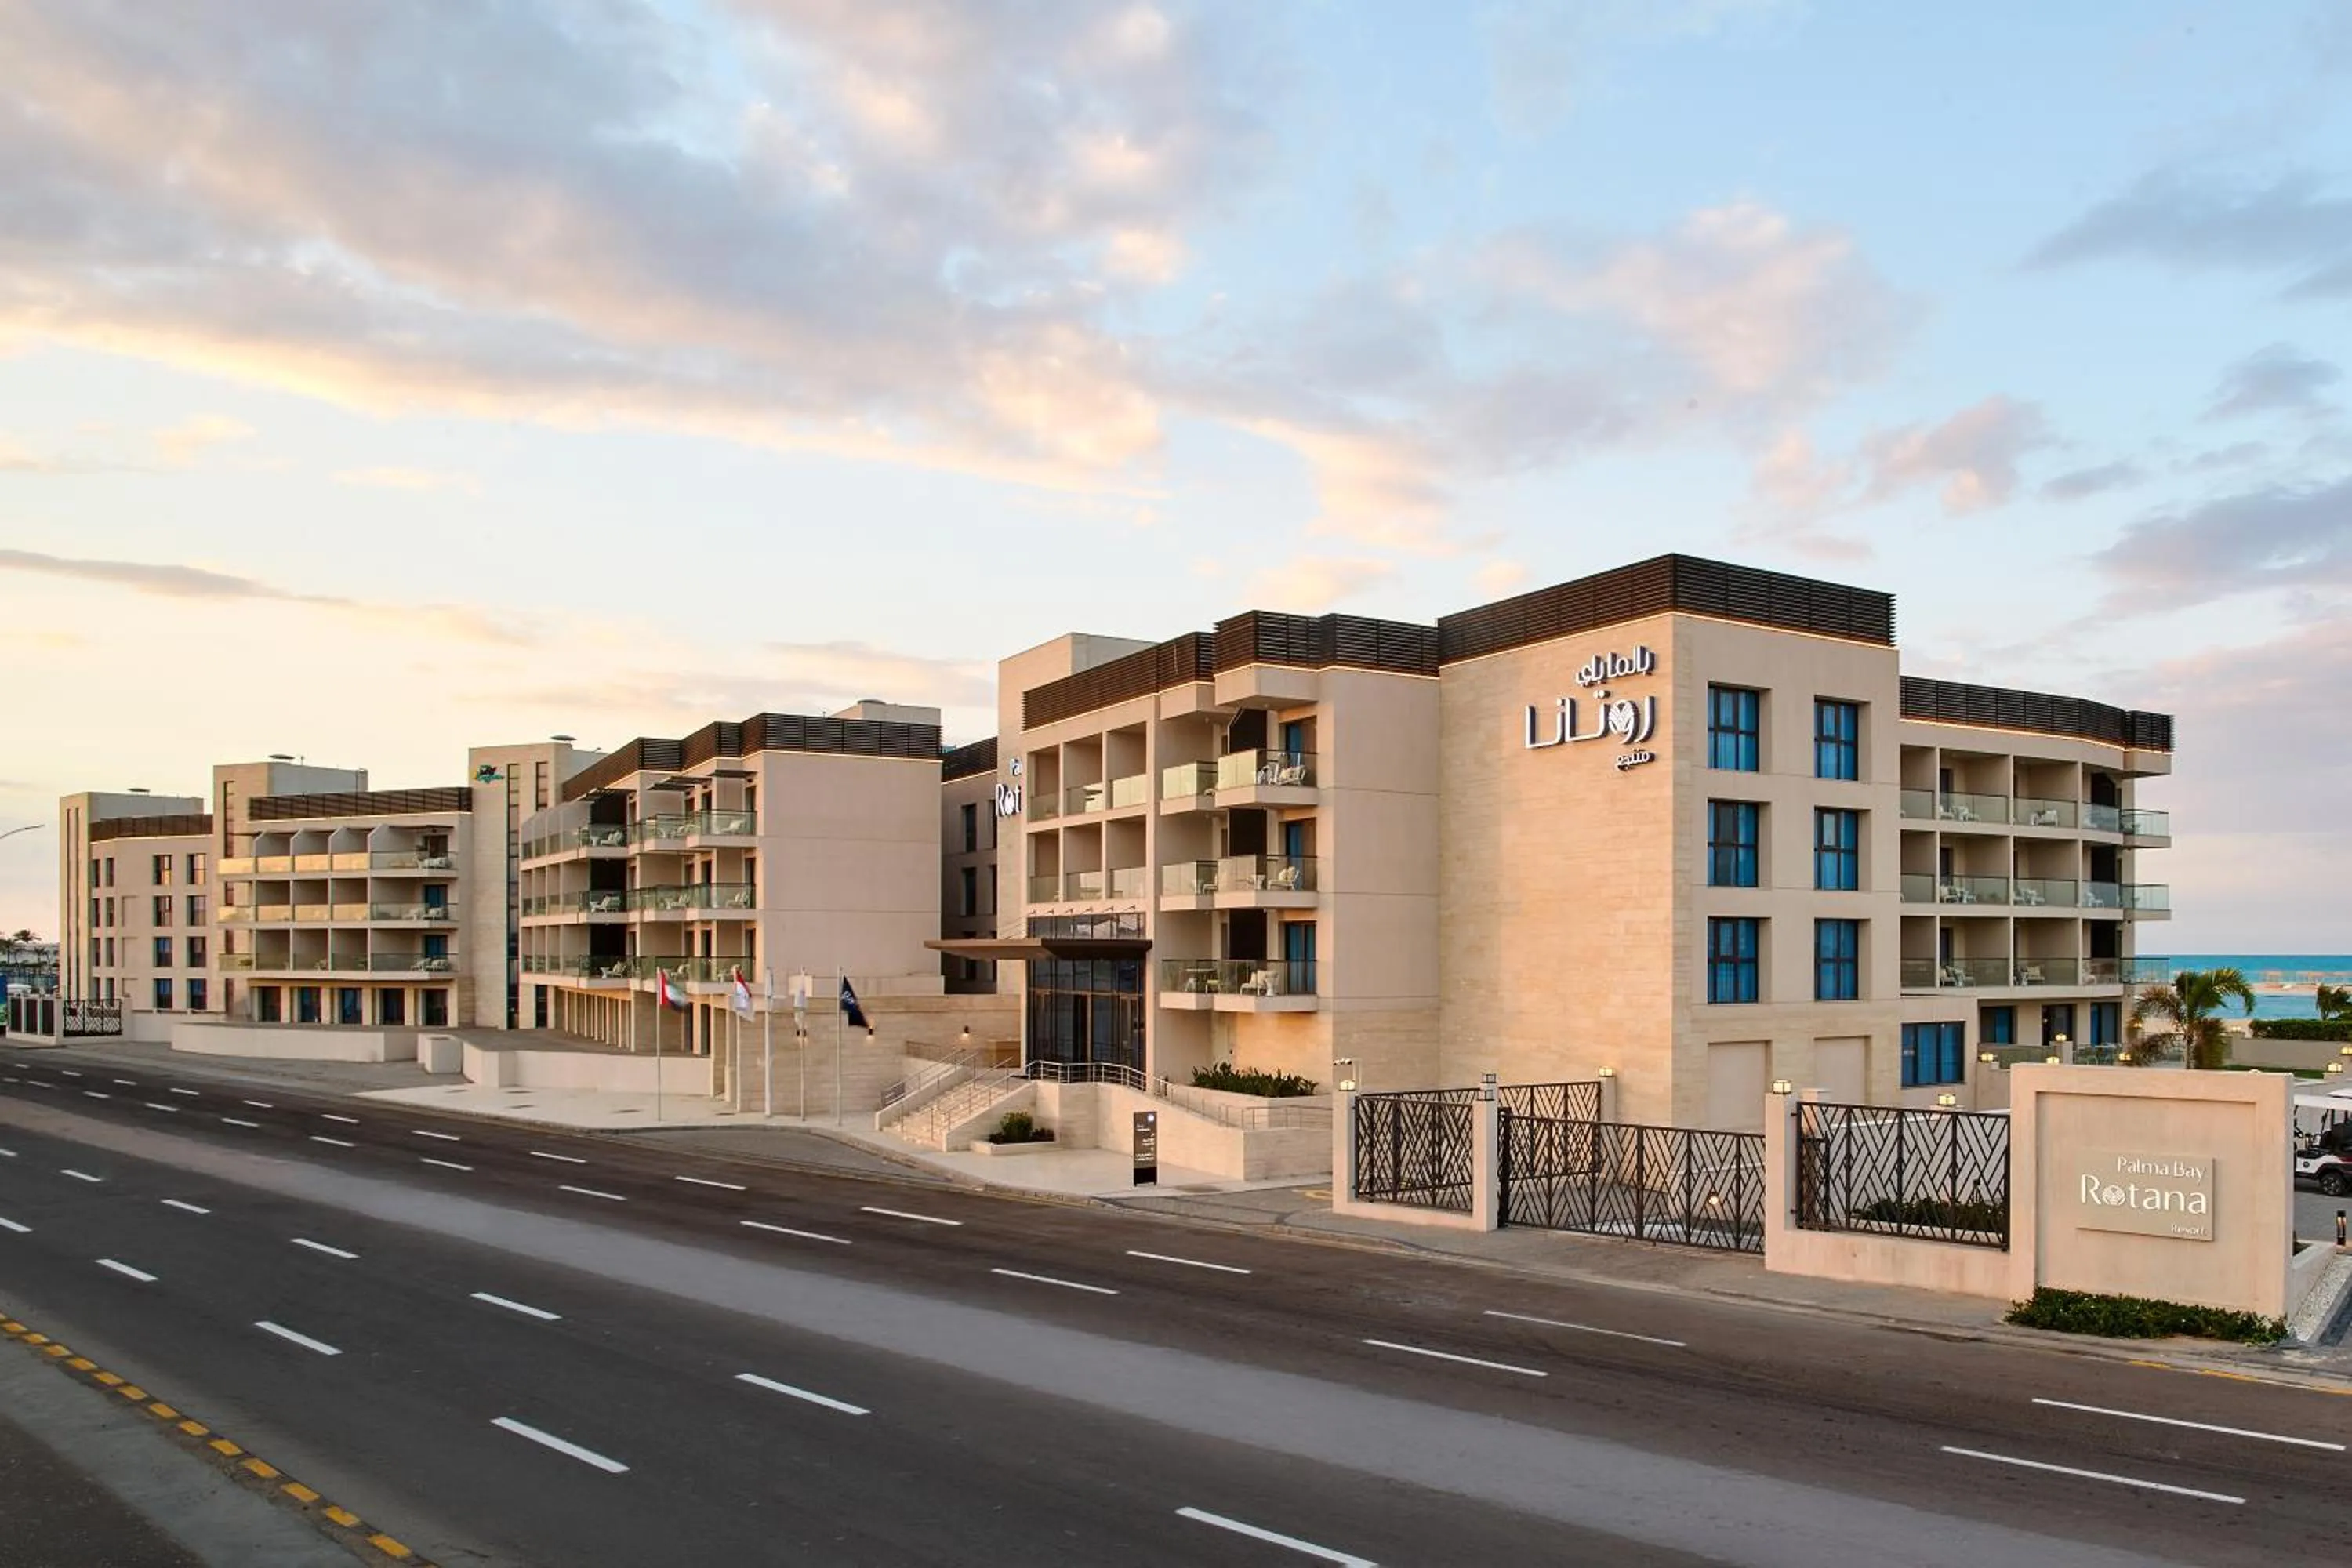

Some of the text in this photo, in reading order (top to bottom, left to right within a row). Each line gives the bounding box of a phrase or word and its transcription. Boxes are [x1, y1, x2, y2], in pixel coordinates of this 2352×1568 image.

[1525, 689, 1651, 749] روتانا
[996, 783, 1021, 816] Rot
[2117, 1156, 2207, 1185] Palma Bay
[2082, 1174, 2208, 1214] Rotana
